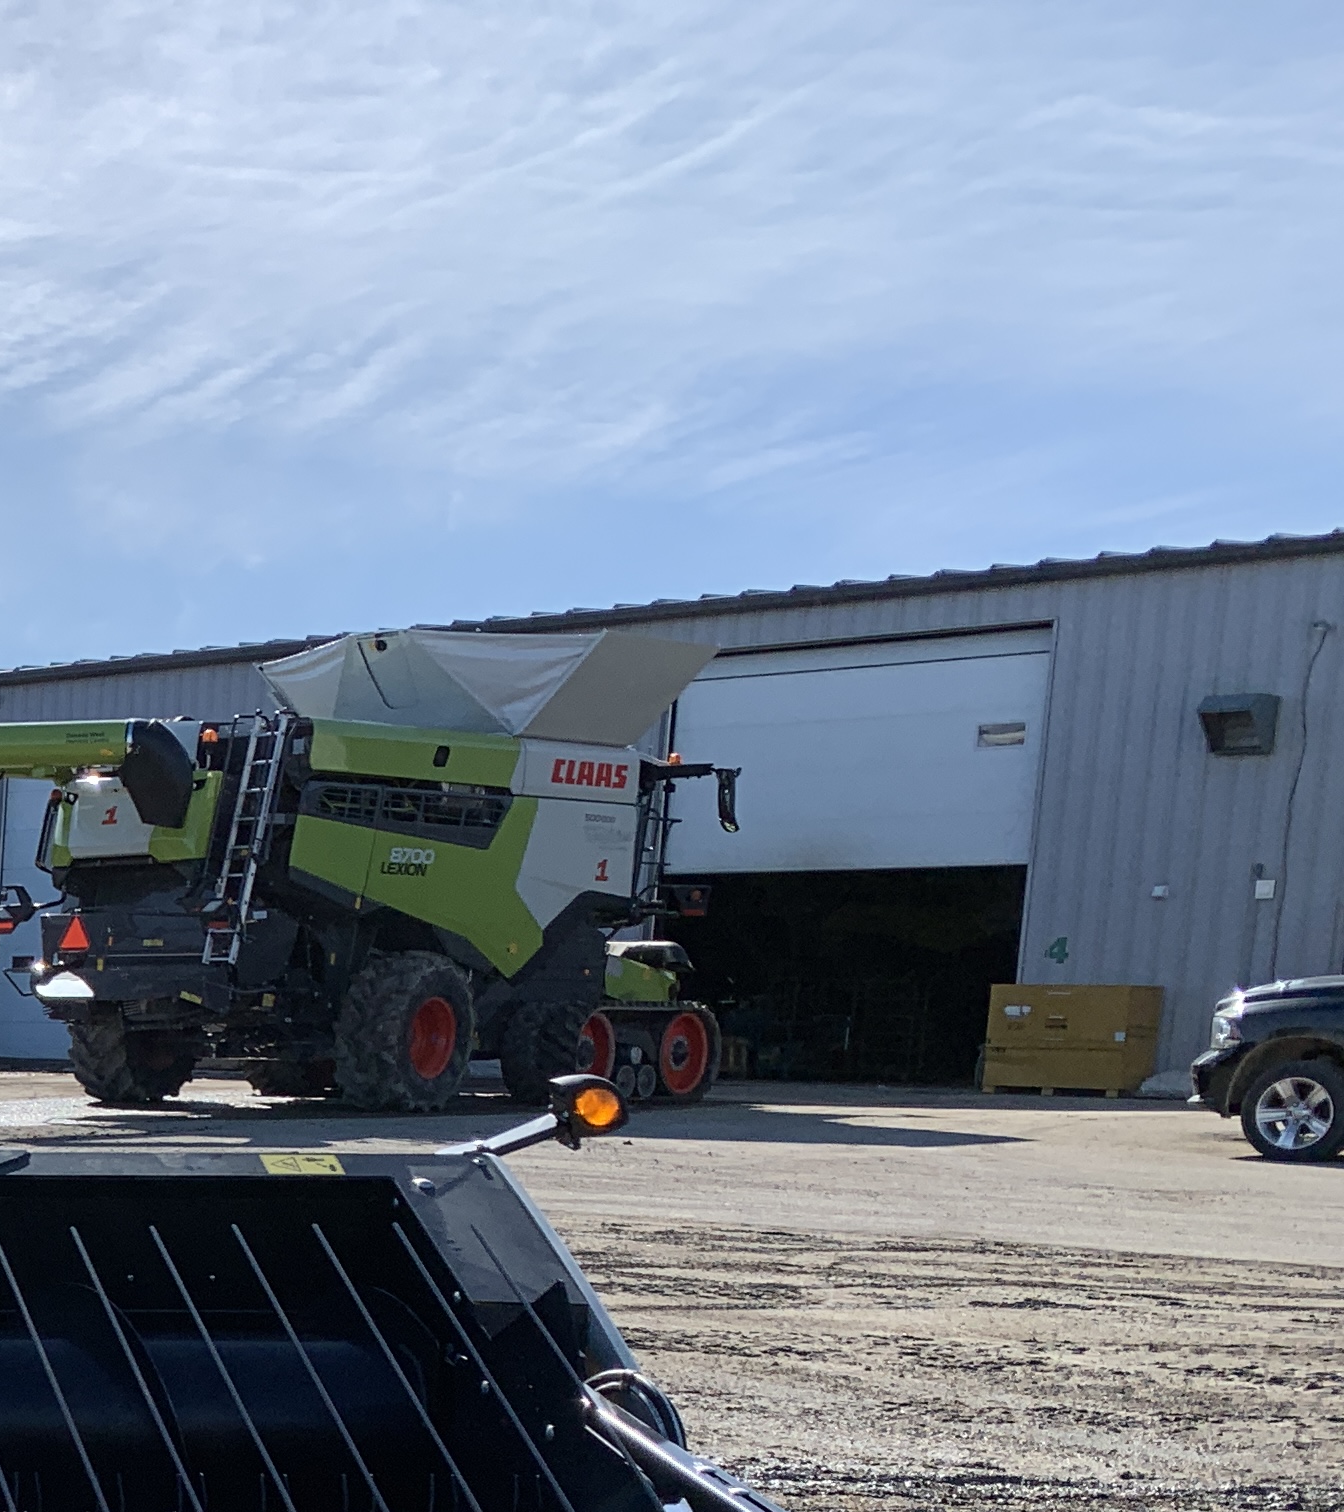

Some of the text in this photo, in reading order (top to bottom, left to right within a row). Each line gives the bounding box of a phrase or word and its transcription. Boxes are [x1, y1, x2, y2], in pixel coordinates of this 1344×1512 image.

[550, 758, 629, 789] CLAAS
[101, 805, 118, 825] 1
[390, 847, 435, 865] 8700
[380, 861, 428, 876] LEXION
[594, 859, 609, 882] 1
[1044, 936, 1069, 964] 4
